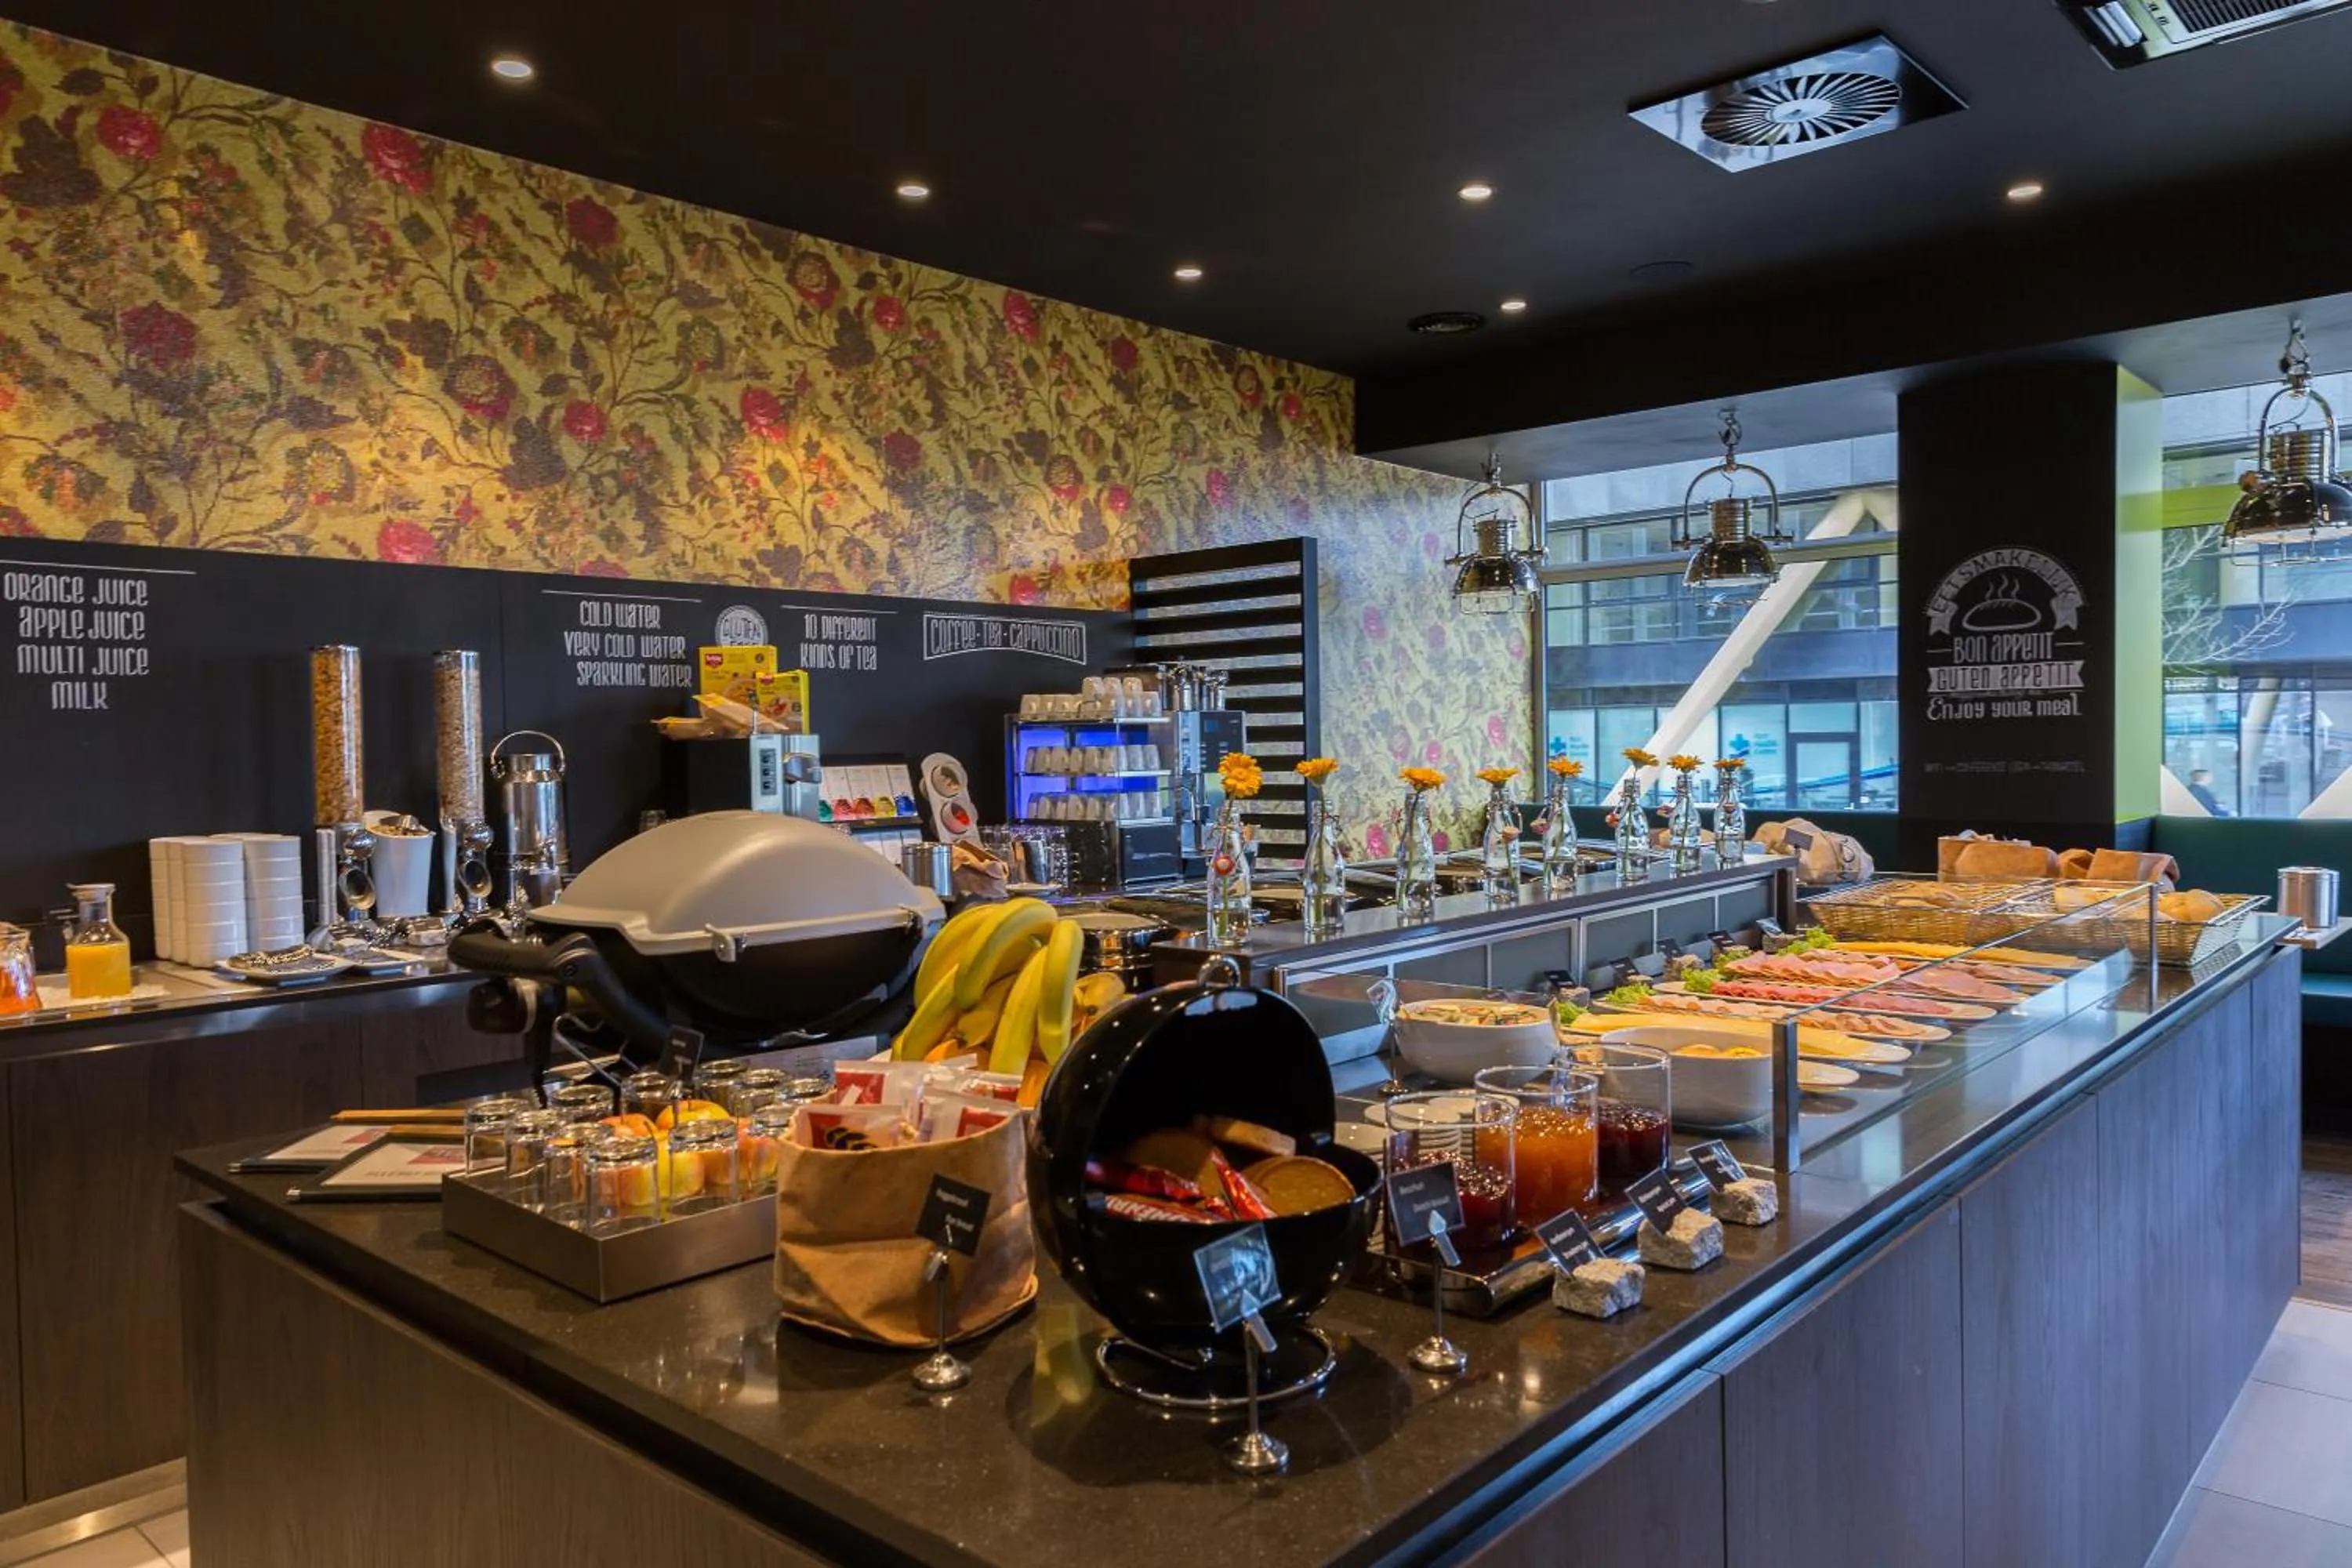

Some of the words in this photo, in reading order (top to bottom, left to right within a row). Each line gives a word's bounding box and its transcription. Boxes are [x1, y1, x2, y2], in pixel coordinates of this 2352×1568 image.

[4, 572, 85, 603] ORANGE
[92, 578, 149, 606] JUICE
[19, 605, 85, 639] APPLE
[88, 611, 146, 641] JUICE
[579, 601, 612, 626] COLD
[615, 603, 661, 629] WATER
[804, 614, 818, 639] 10
[822, 615, 877, 641] DIFFERENT
[564, 631, 601, 657] VERY
[604, 633, 635, 658] COLD
[641, 634, 687, 659] WATER
[931, 619, 976, 655] COFFEE
[982, 621, 1003, 647] TEA
[1009, 623, 1080, 659] CAPPUCCINO
[1953, 635, 1987, 664] BON
[16, 644, 85, 674] MULTI
[92, 647, 150, 676] JUICE
[800, 642, 836, 669] KINDS
[839, 644, 854, 670] OF
[856, 645, 877, 670] TEA
[576, 661, 646, 687] SPARKLING
[649, 663, 692, 688] WATER
[51, 681, 110, 710] MILK
